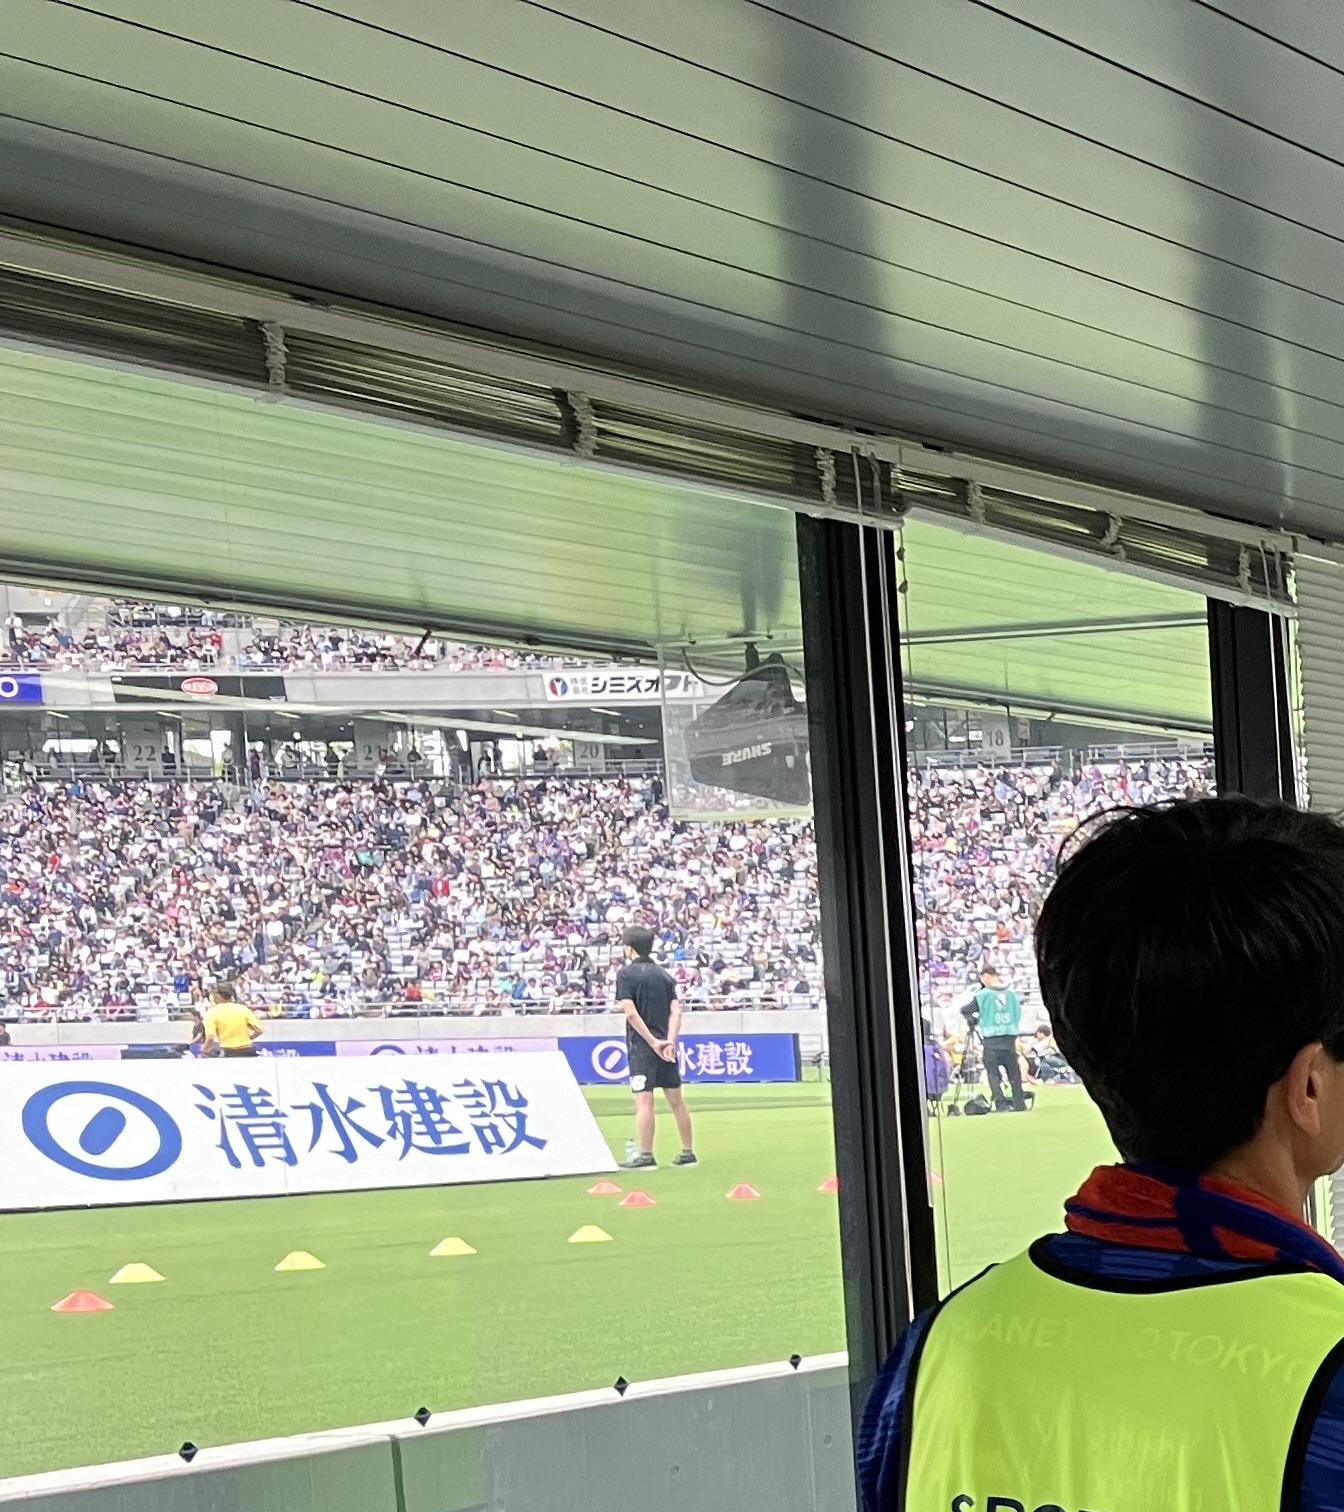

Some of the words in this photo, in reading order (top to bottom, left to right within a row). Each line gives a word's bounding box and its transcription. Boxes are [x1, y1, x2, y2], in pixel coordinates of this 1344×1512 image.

[132, 744, 157, 762] 22
[721, 741, 772, 767] SHURE
[677, 1041, 753, 1076] 水建設
[192, 1078, 547, 1169] 清水建設
